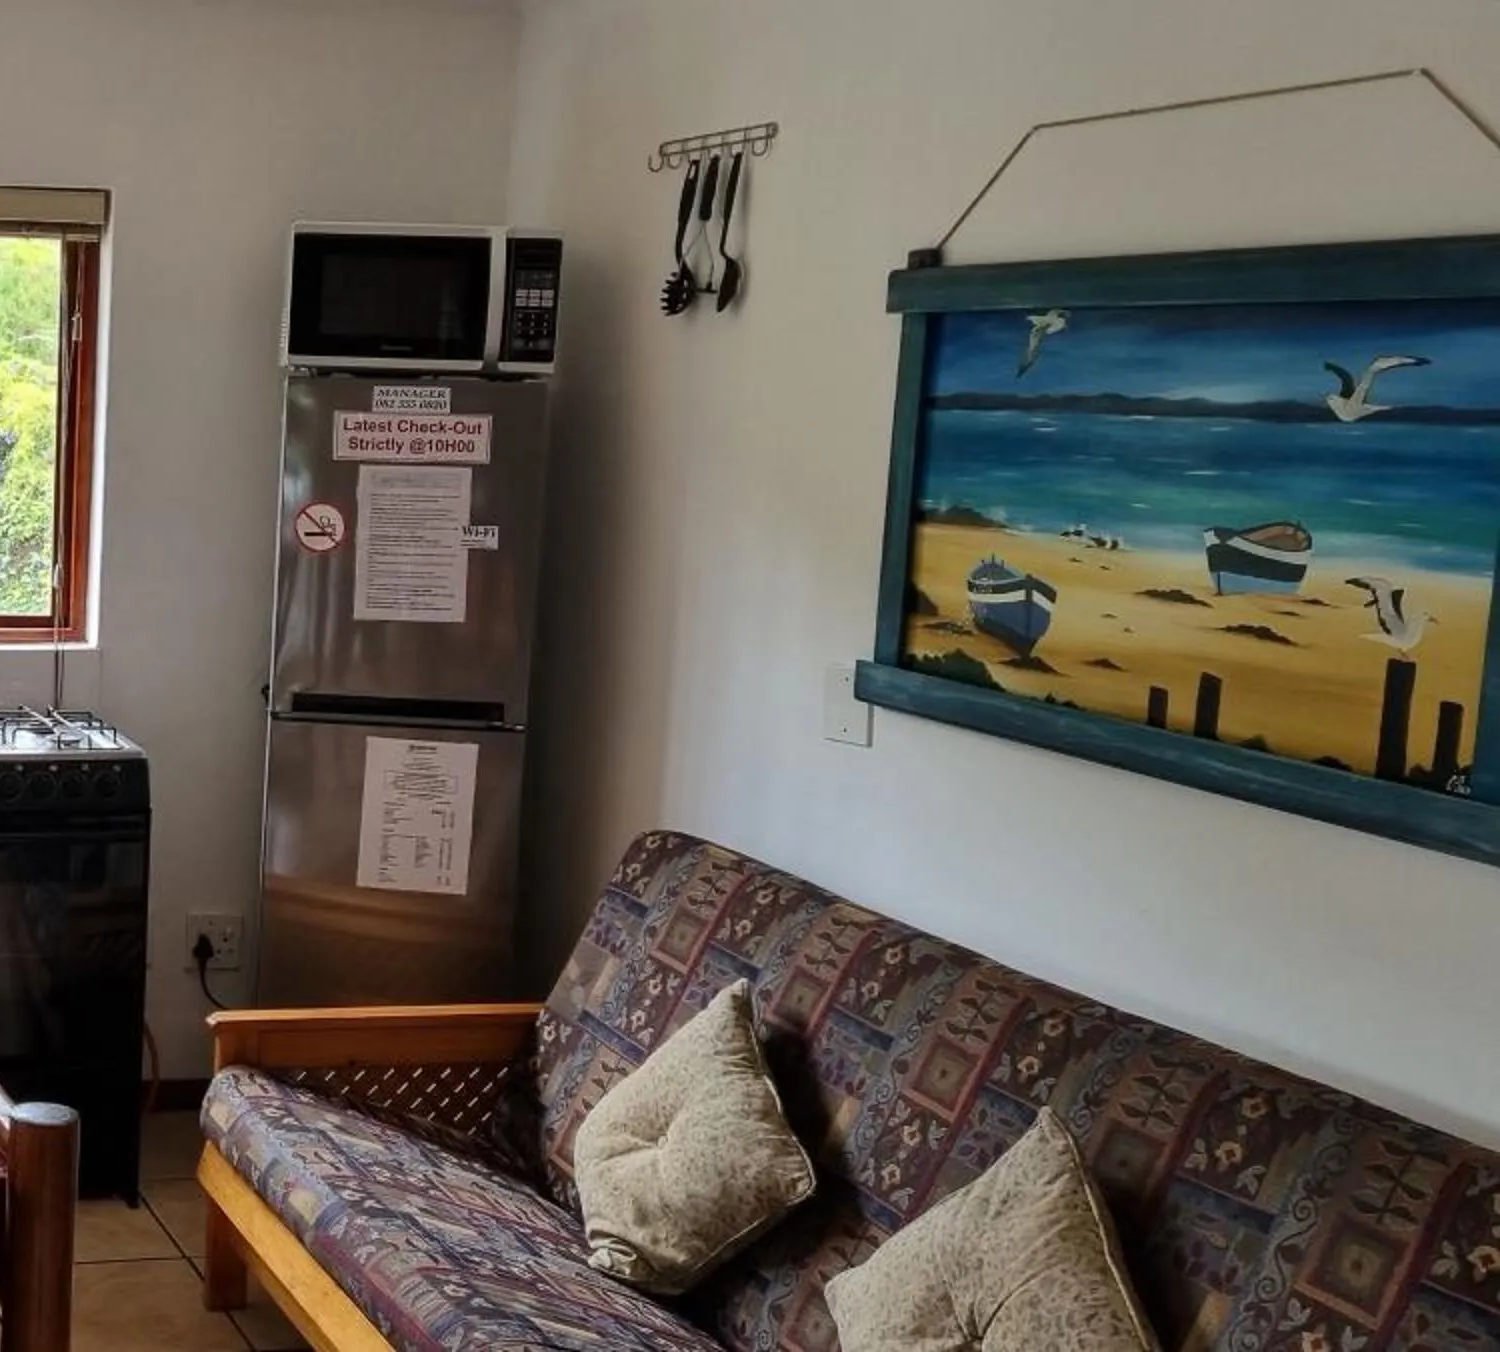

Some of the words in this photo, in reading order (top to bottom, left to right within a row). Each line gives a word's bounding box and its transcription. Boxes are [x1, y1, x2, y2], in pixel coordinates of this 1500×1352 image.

[378, 389, 445, 398] MANAGER
[343, 418, 393, 433] Latest
[397, 419, 482, 435] Check-Out
[348, 436, 404, 454] Strictly
[409, 438, 476, 454] @10H00
